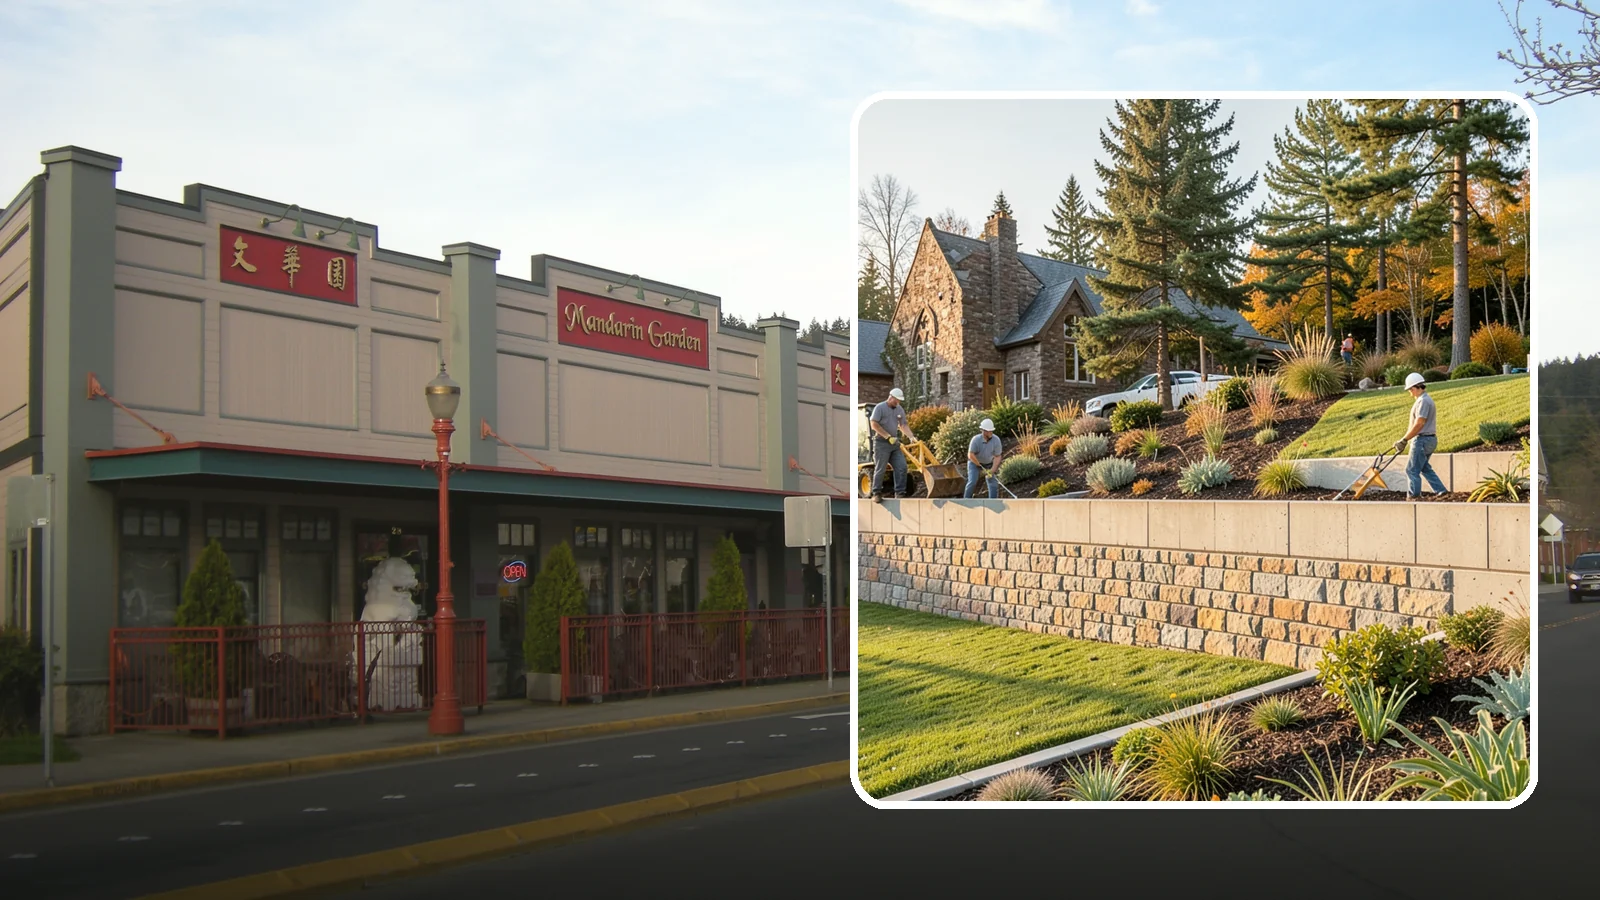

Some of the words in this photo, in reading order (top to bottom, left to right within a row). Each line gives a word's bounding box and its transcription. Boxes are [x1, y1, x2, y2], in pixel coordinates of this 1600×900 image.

[231, 236, 346, 290] 文華園
[565, 302, 643, 340] Mandarin
[648, 320, 701, 351] Garden
[504, 565, 526, 578] OPEN
